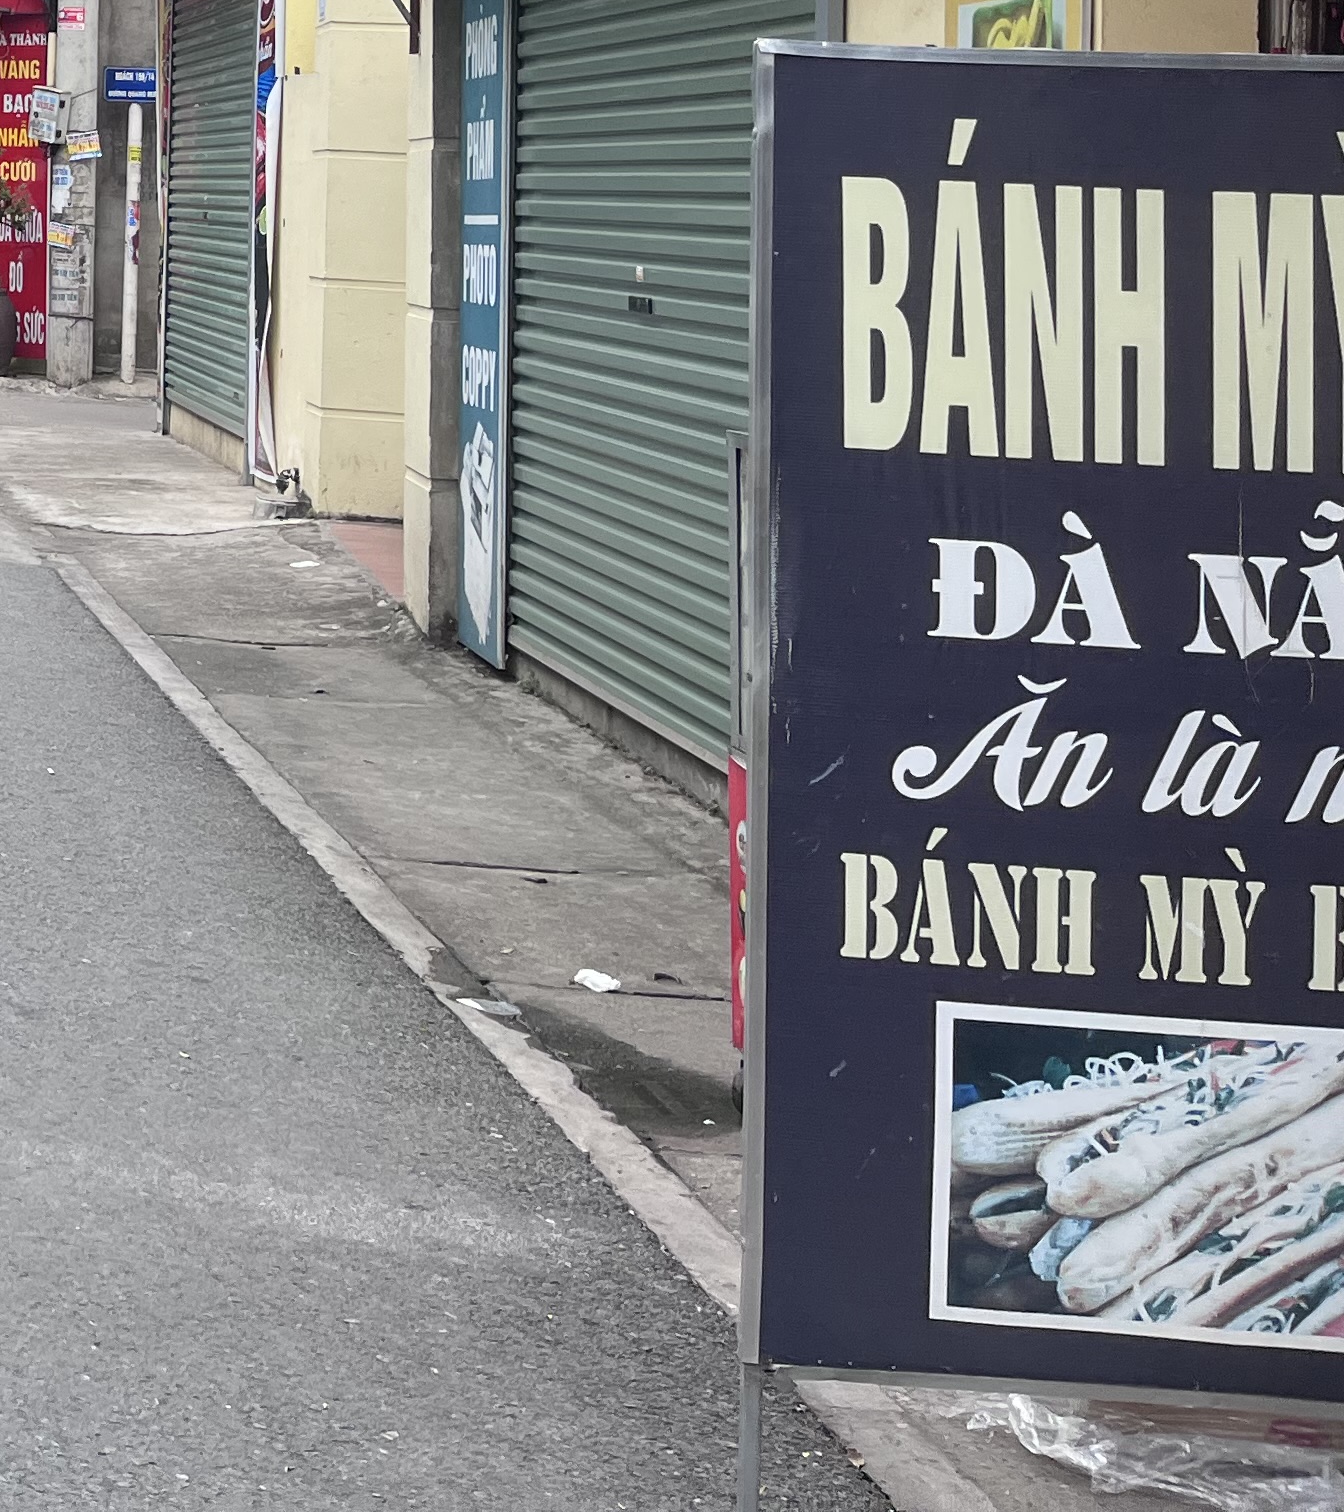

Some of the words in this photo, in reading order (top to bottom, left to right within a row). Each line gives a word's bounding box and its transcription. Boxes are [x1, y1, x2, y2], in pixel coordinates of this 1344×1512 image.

[9, 29, 48, 47] THÀNH
[465, 3, 498, 80] PHÒNG
[0, 157, 37, 182] CƯỚI
[467, 94, 494, 180] PHẨM
[463, 243, 497, 307] PHOTO
[841, 118, 1165, 468] BÁNH
[1212, 131, 1344, 474] M
[23, 305, 45, 345] SỨC
[463, 344, 497, 412] COPPY
[927, 510, 1141, 650] ĐÀ
[891, 674, 1113, 813] Ăn
[1142, 709, 1261, 823] là
[840, 827, 1097, 976] BÁNH
[1138, 847, 1266, 986] MỲ
